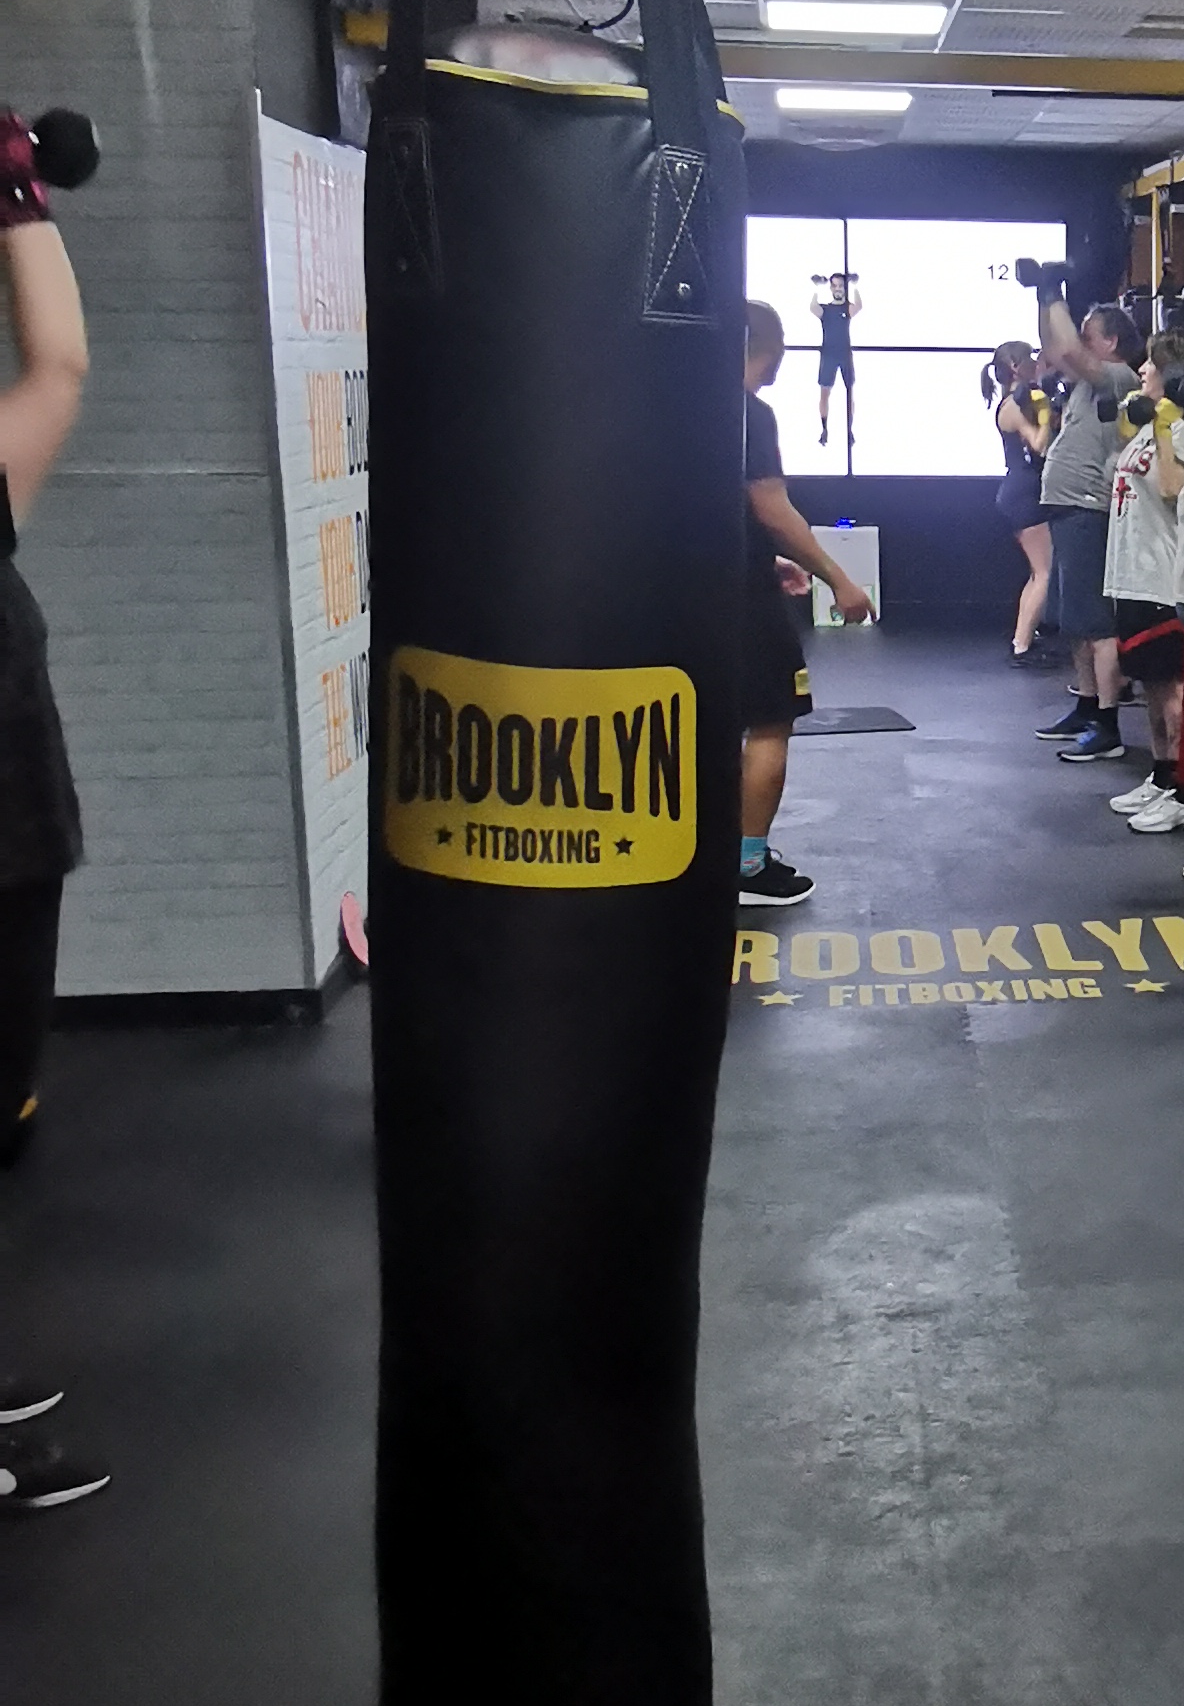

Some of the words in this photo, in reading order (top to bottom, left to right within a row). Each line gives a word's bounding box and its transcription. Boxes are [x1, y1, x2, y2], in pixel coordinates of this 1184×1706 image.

[988, 264, 1009, 280] 12
[397, 674, 681, 822] BROOKLYN
[465, 822, 601, 865] FITBOXING
[828, 977, 1102, 1008] FITBOXING
